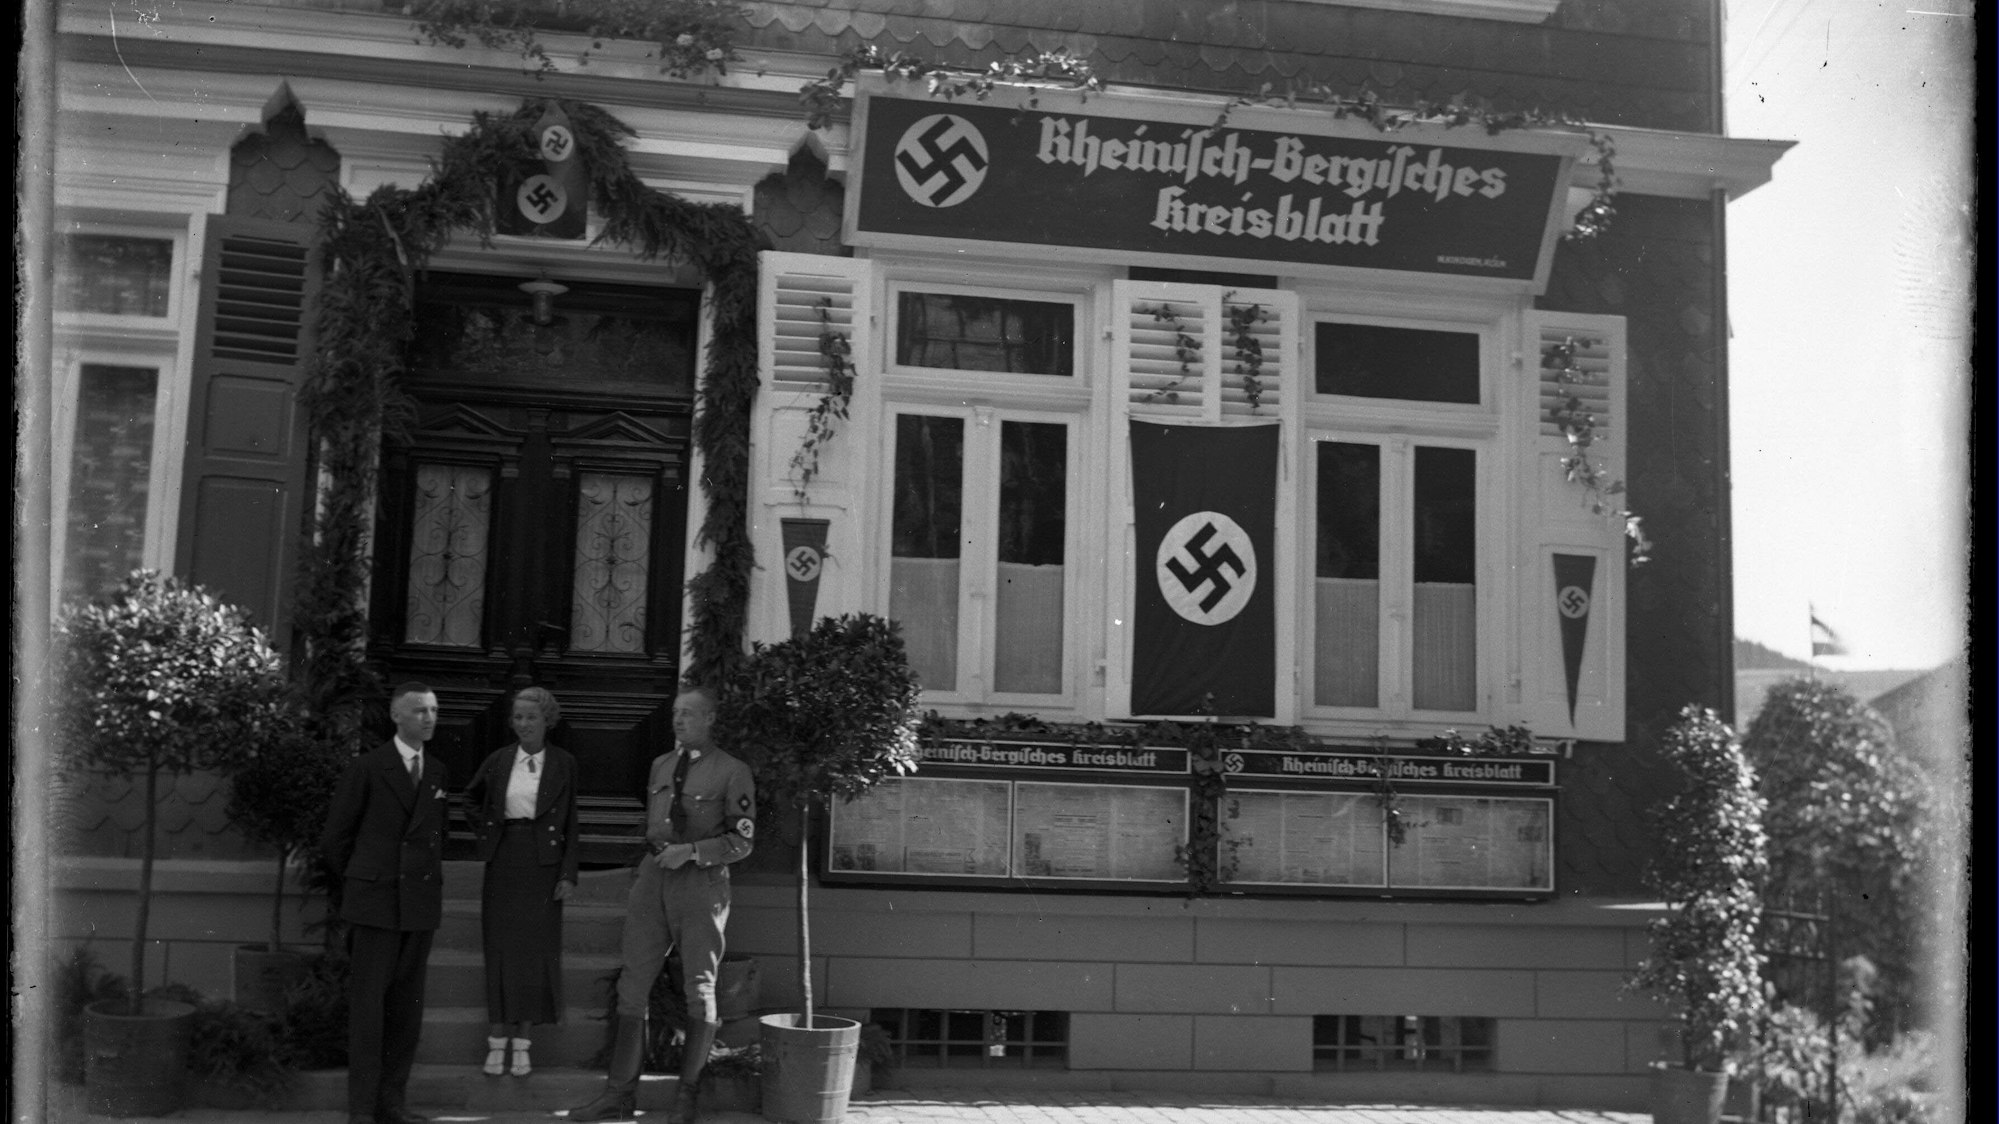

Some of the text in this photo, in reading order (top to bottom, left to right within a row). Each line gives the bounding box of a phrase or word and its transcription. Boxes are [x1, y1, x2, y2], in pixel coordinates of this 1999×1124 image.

[1150, 185, 1385, 246] Kreisblatt
[1073, 750, 1156, 767] Kreisblatt
[1444, 763, 1522, 779] Kreisblatt
